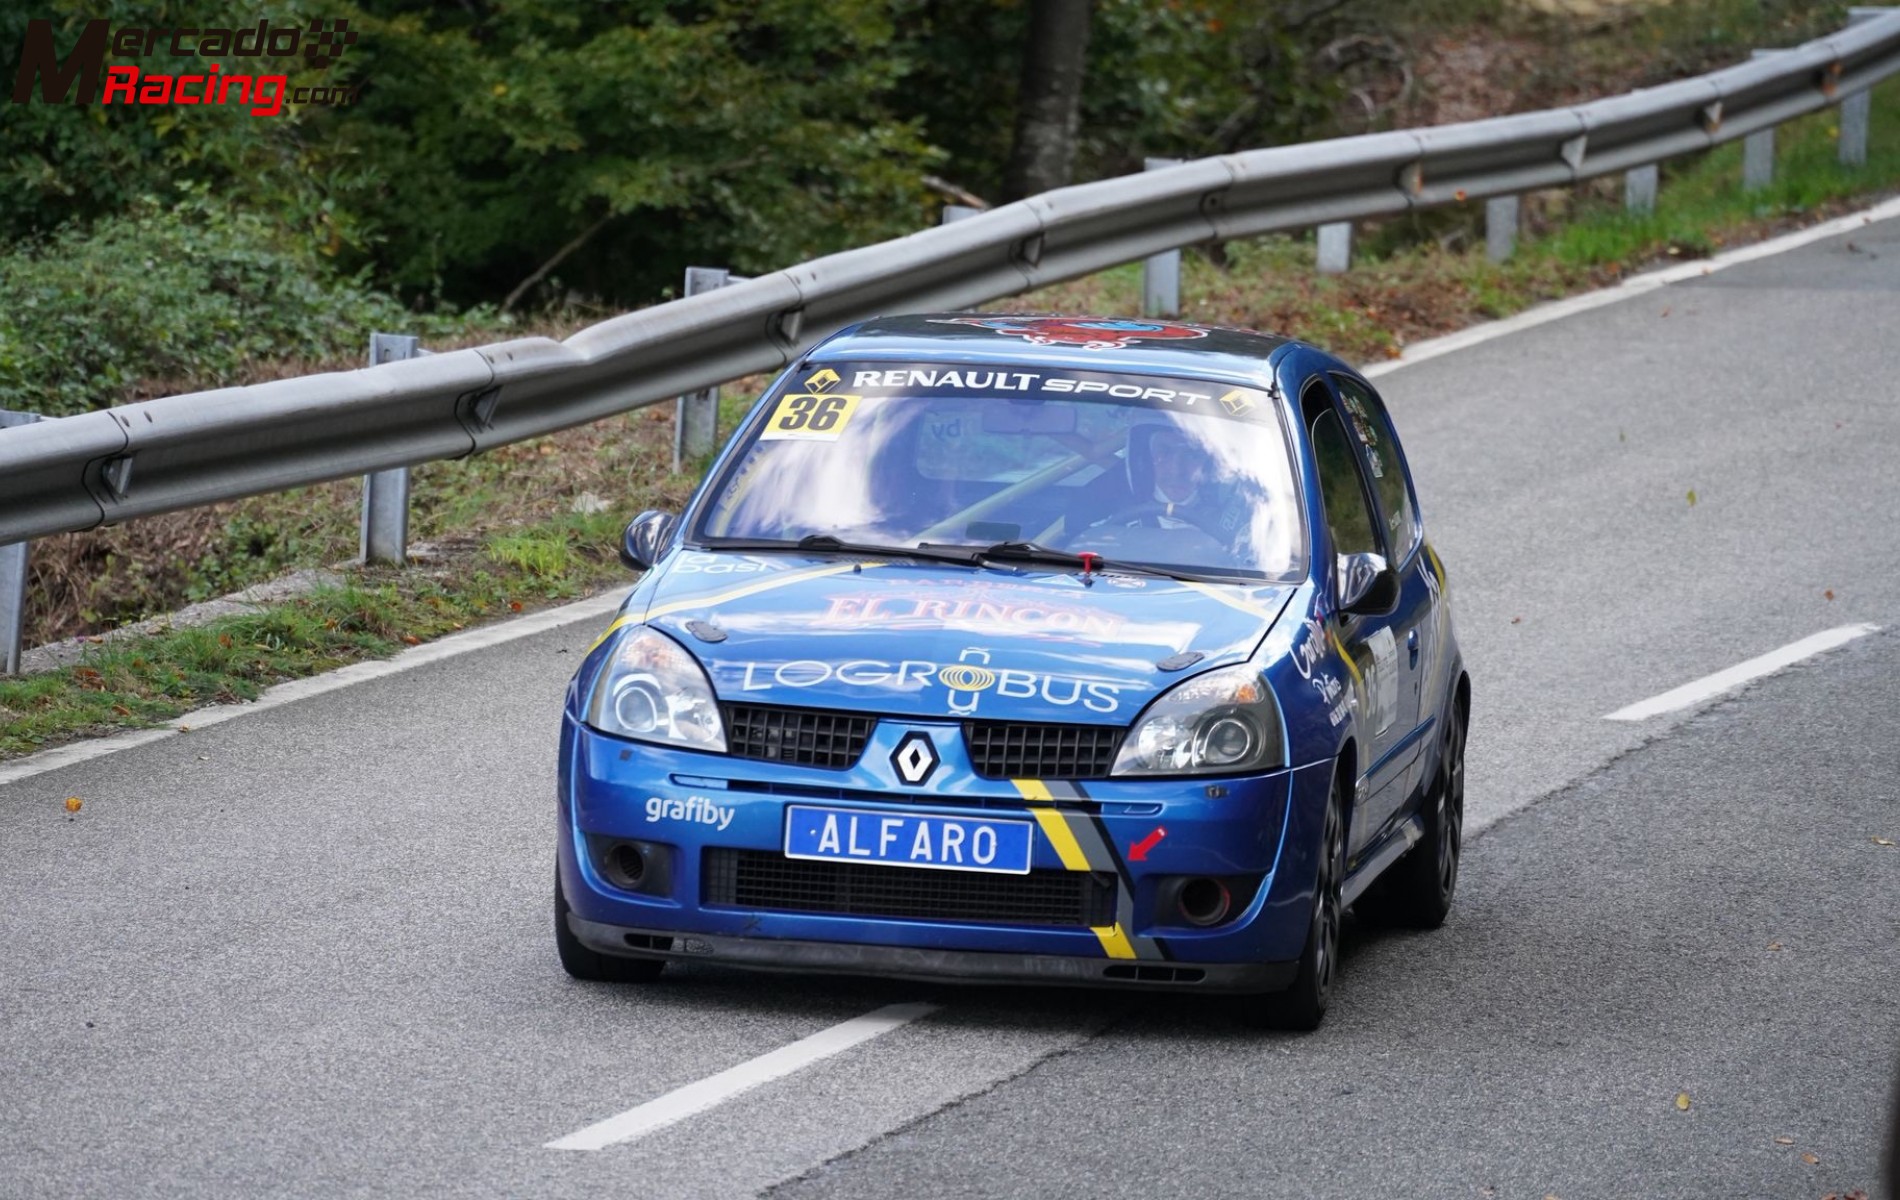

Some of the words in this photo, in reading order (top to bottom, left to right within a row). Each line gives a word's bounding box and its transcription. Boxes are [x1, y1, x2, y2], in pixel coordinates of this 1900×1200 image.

[853, 371, 1040, 390] RENAULT
[1041, 380, 1211, 405] SPORT
[779, 397, 847, 430] 36
[825, 597, 891, 620] EL
[910, 599, 1117, 632] RINCON
[645, 796, 735, 831] grafiby
[818, 814, 998, 865] ALFARO
